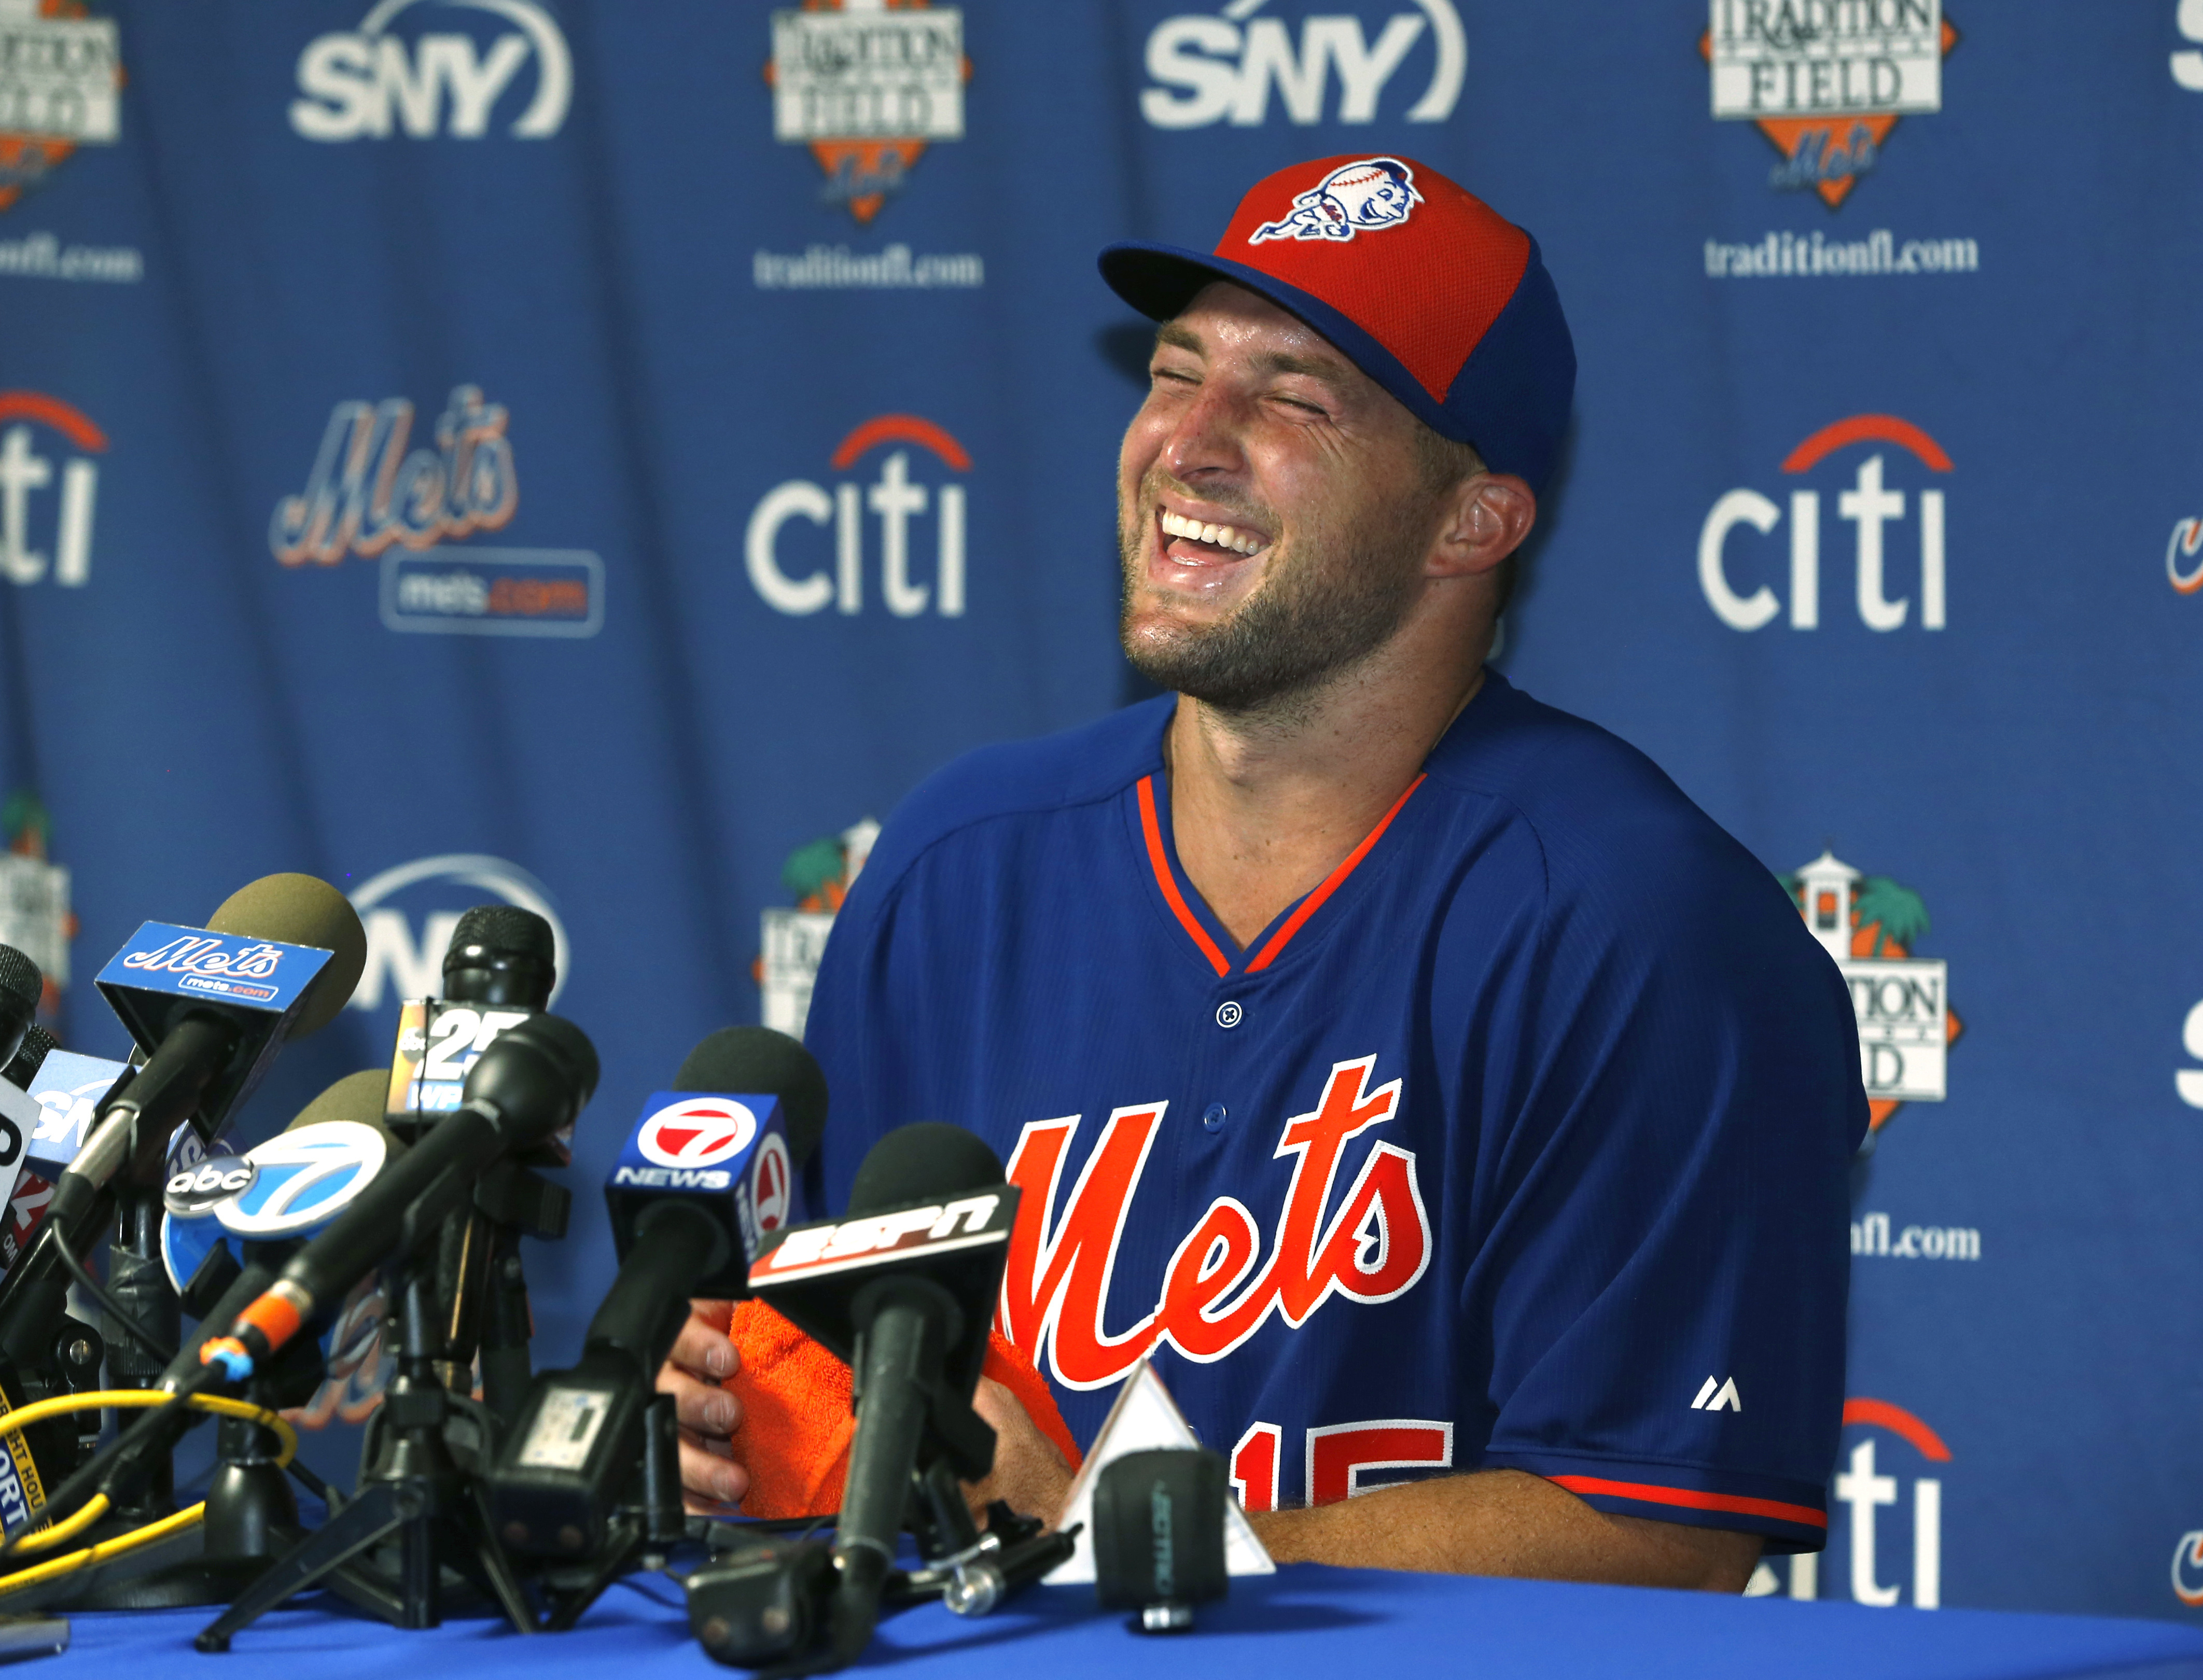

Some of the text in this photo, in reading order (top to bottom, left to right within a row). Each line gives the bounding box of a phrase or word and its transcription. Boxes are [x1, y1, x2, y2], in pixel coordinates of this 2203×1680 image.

[288, 30, 532, 142] SNY
[1140, 13, 1427, 130] SNY
[1749, 56, 1901, 109] FIELD
[1704, 230, 1979, 277] traditionfl.com
[0, 426, 97, 587] ti
[269, 384, 518, 567] Mets
[744, 449, 967, 617] citi
[1697, 453, 1946, 632] citi
[123, 936, 283, 978] Mets
[186, 977, 270, 999] mets.com
[33, 1090, 94, 1147] SN
[166, 1165, 252, 1193] abc
[614, 1166, 731, 1189] NEWS
[770, 1194, 1000, 1269] ESPN
[992, 1054, 1432, 1391] Mets
